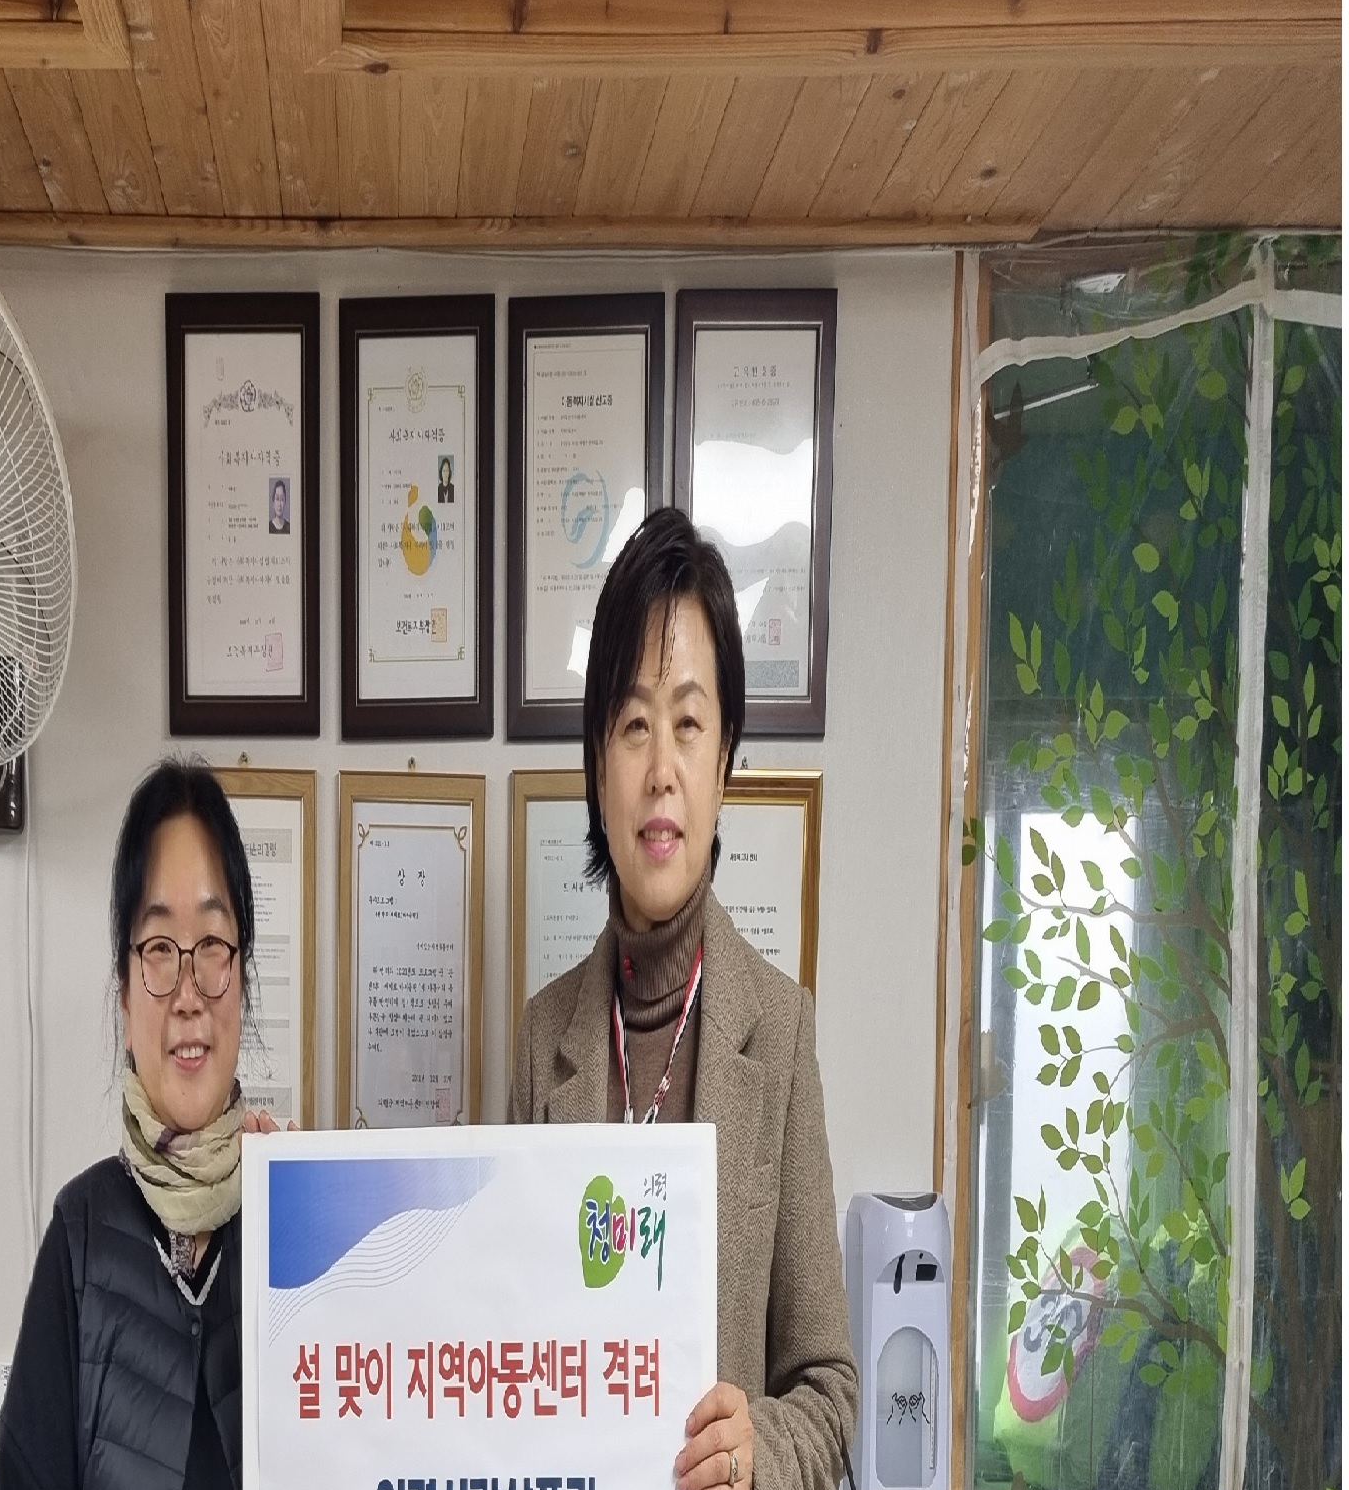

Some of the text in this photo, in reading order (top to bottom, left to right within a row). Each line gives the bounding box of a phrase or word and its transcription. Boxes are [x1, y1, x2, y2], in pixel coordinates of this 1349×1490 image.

[643, 1171, 668, 1201] 의령
[586, 1196, 666, 1292] 청미래
[292, 1338, 661, 1421] 설 맞이 지역아동센터 격려
